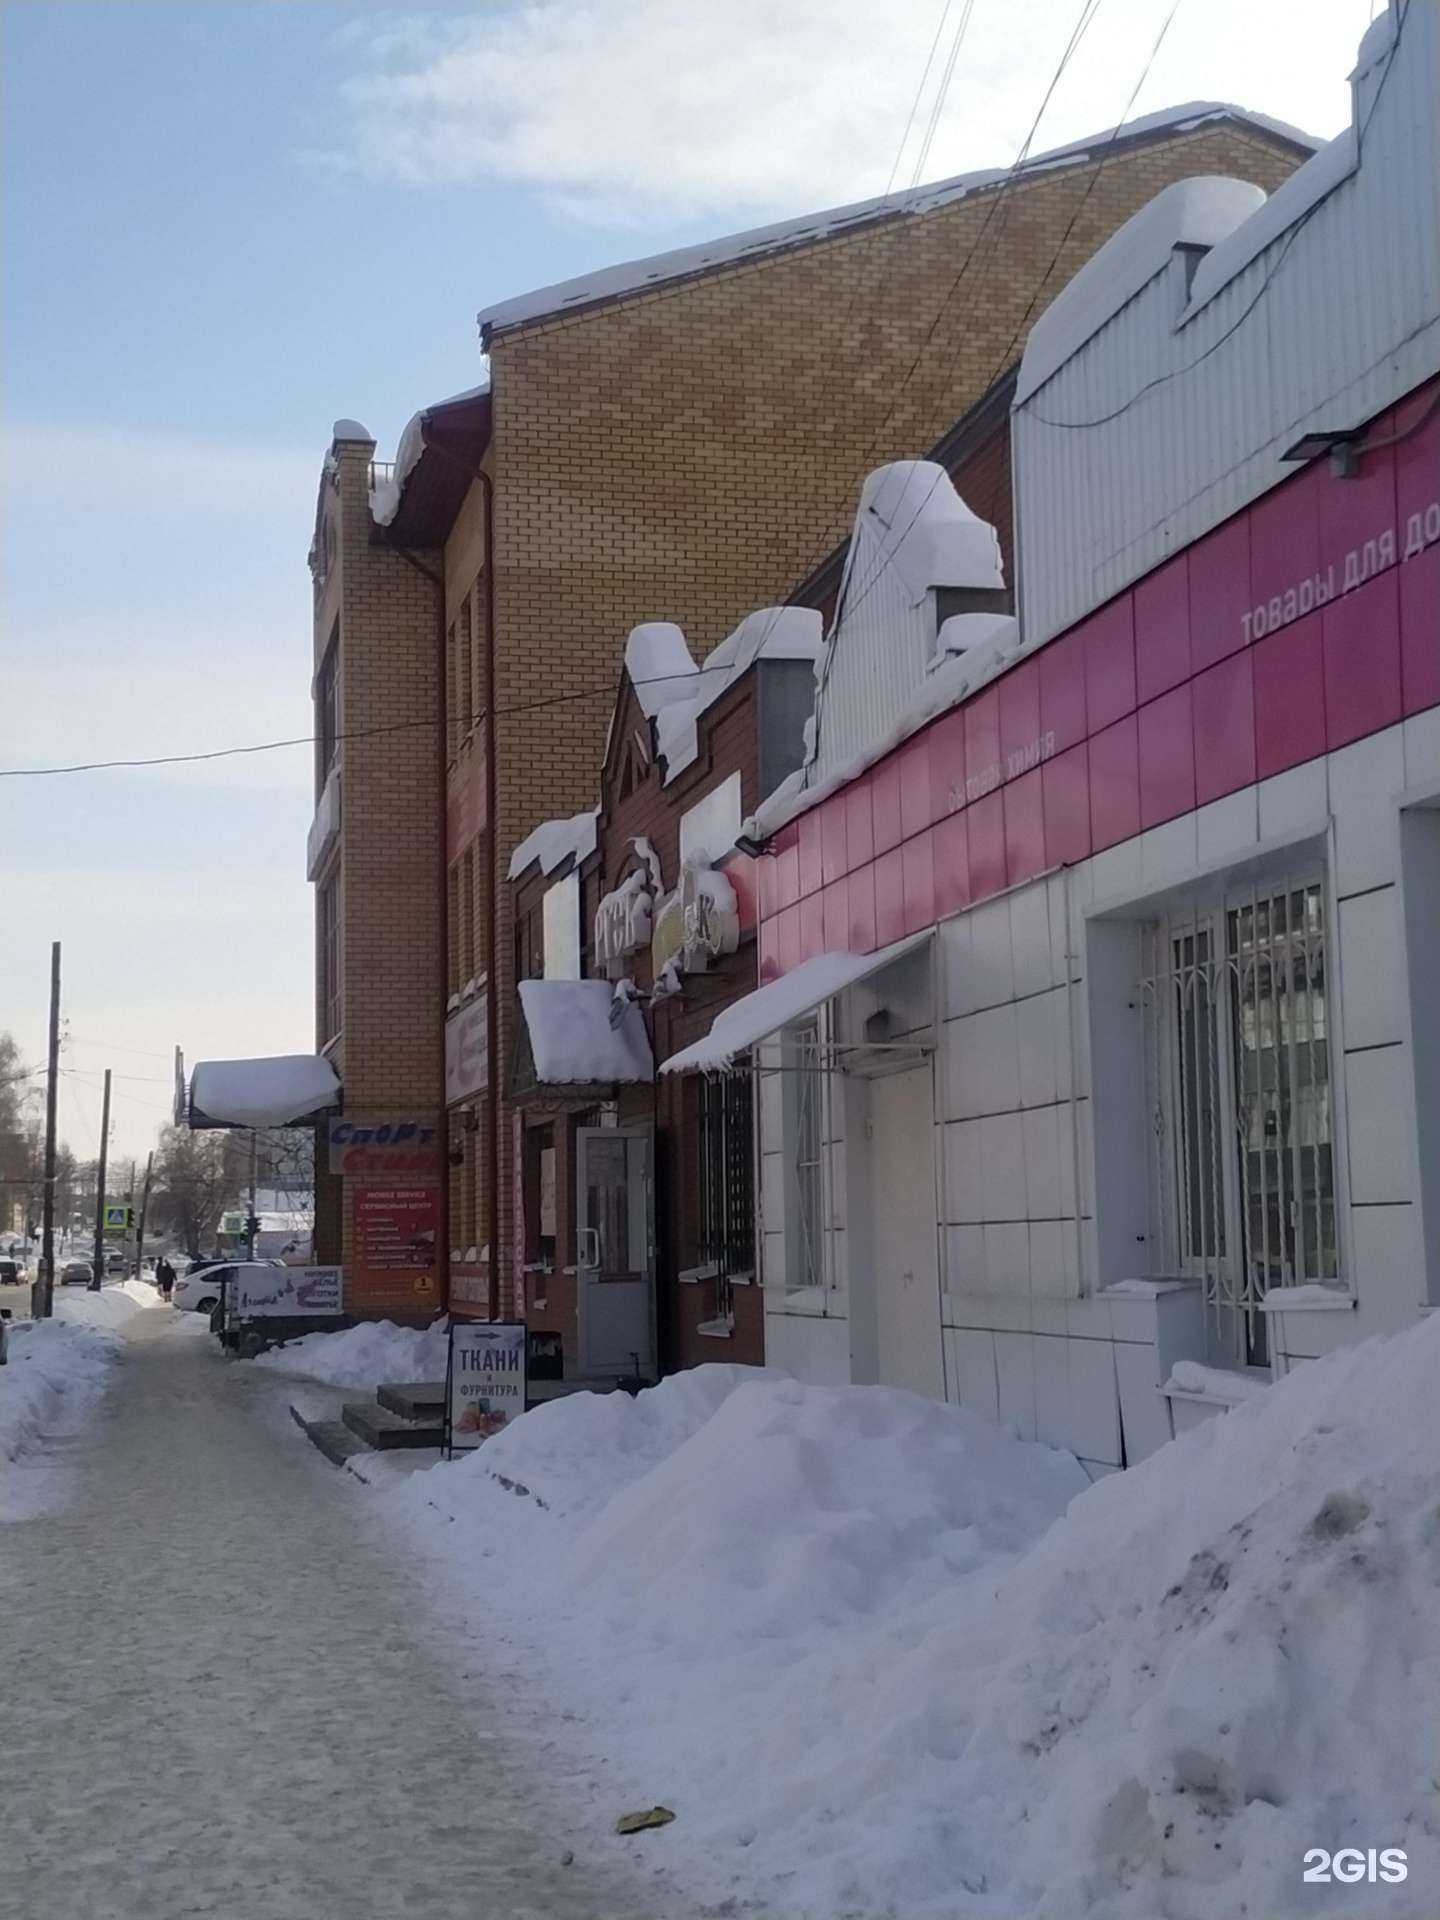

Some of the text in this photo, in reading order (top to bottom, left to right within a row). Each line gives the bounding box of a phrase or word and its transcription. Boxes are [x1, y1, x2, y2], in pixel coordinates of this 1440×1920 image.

[1240, 565, 1335, 646] товары
[1342, 529, 1396, 597] для
[460, 1349, 519, 1372] ТКАНИ
[460, 1384, 519, 1397] ФУРНИТУРА
